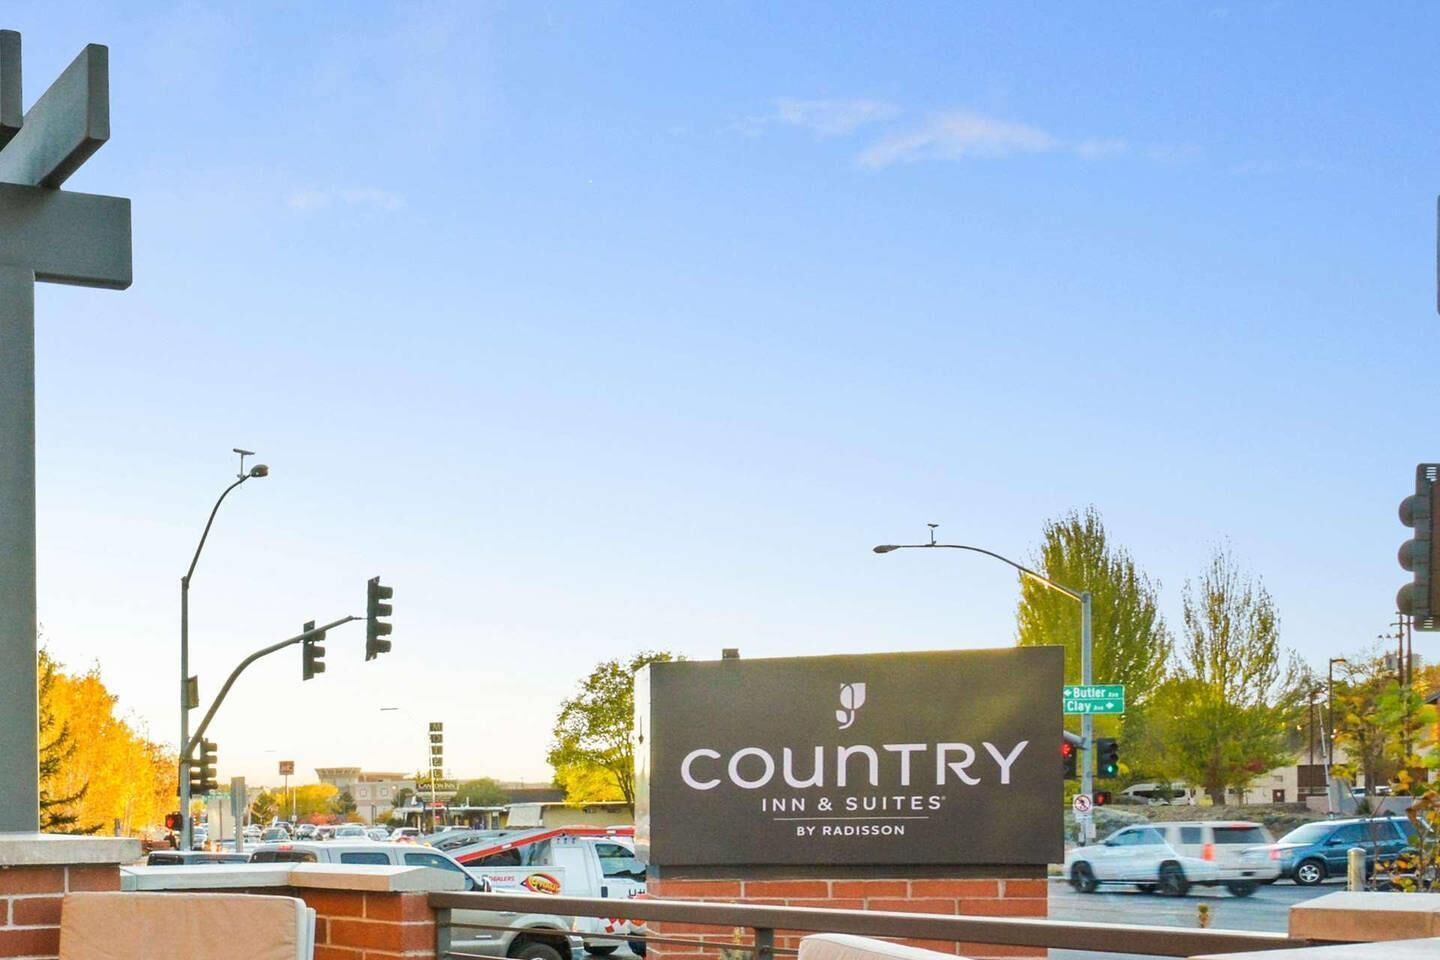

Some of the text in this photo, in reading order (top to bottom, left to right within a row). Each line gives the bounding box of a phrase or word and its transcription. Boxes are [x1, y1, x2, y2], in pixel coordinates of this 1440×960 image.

[1073, 688, 1106, 698] Butler
[1067, 701, 1091, 713] Clay
[762, 795, 942, 812] INN & SUITES
[796, 825, 905, 837] BY RADISSON
